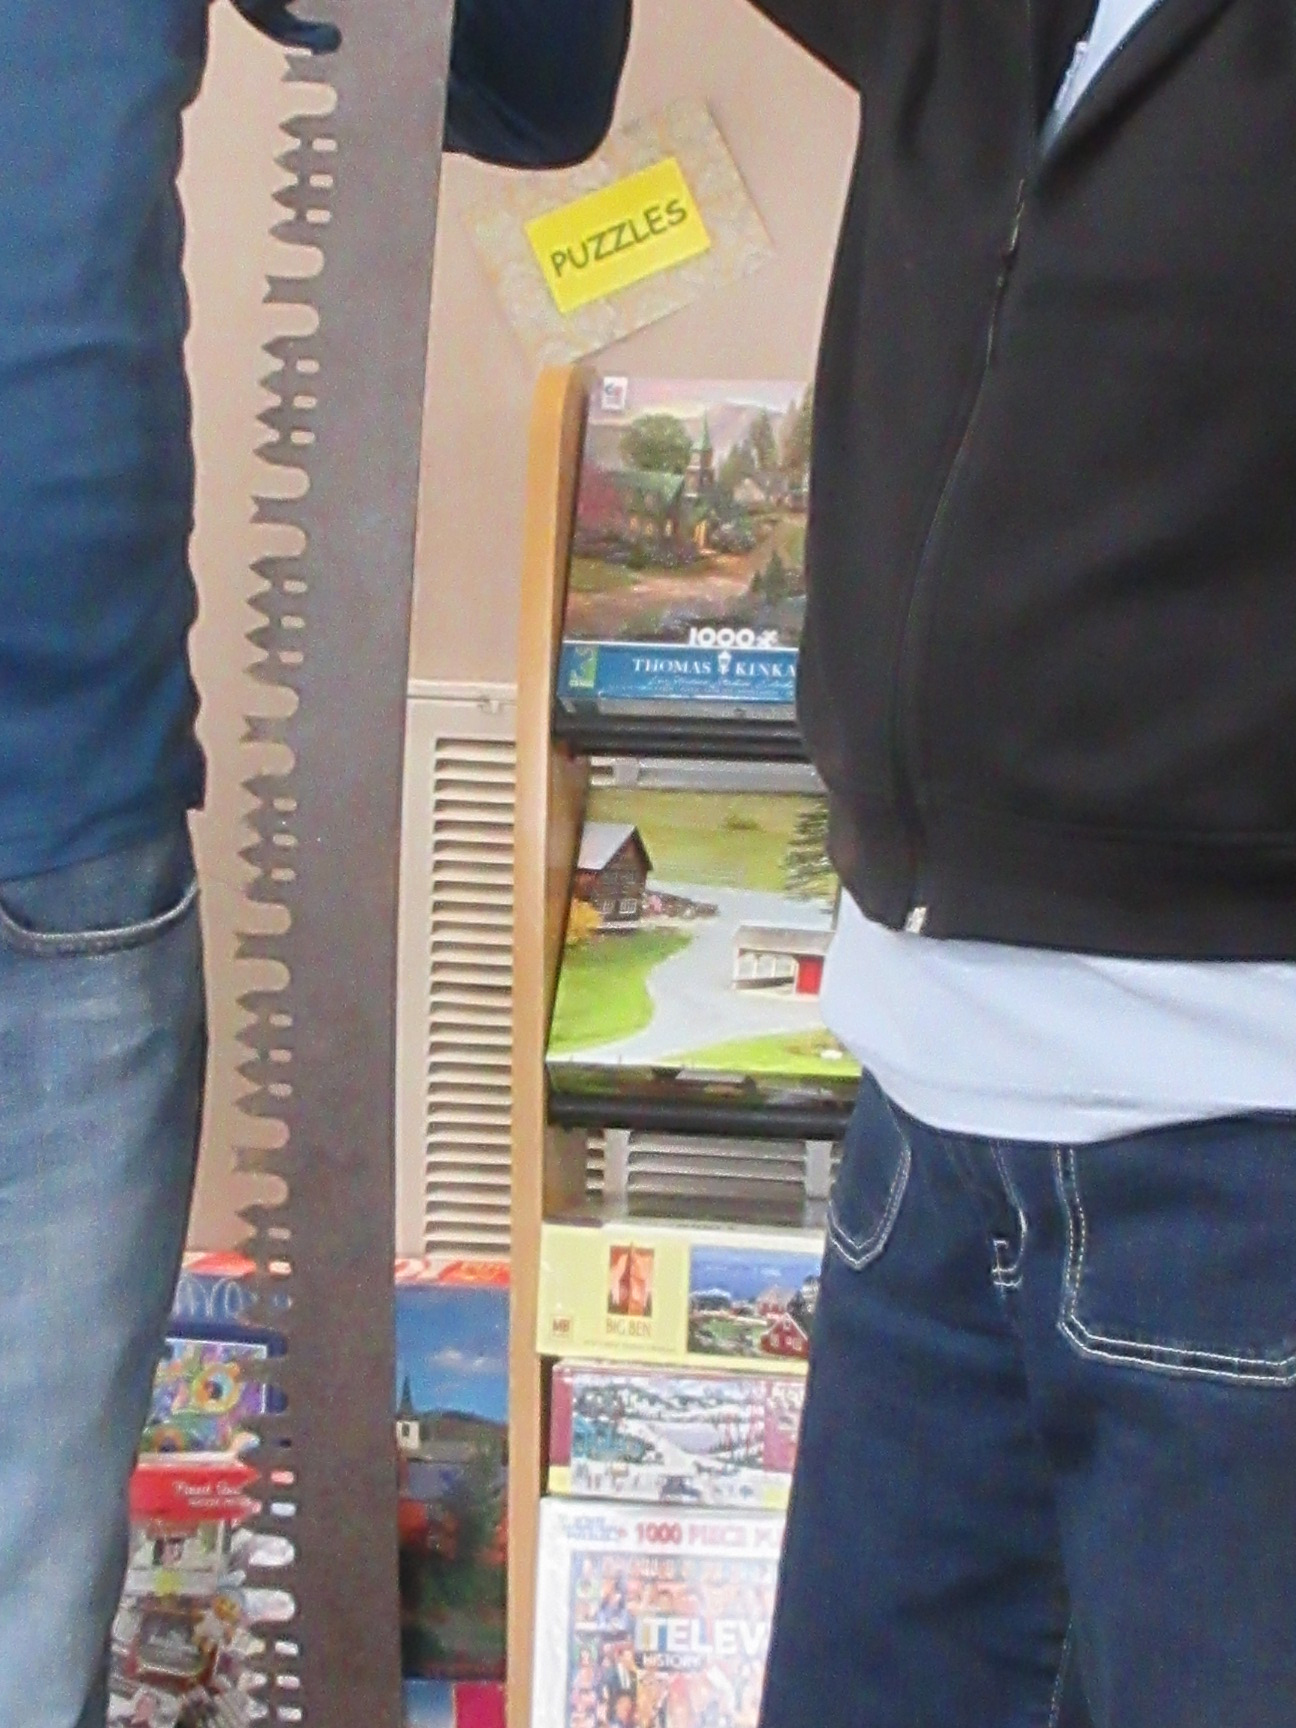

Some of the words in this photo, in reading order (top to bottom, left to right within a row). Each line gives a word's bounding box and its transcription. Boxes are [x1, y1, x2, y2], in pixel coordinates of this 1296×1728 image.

[549, 197, 689, 277] PUZZLES
[688, 626, 755, 649] 1000
[631, 657, 712, 675] THOMAS
[605, 1318, 626, 1336] BIG
[628, 1319, 652, 1338] BEN
[635, 1521, 684, 1546] 1000
